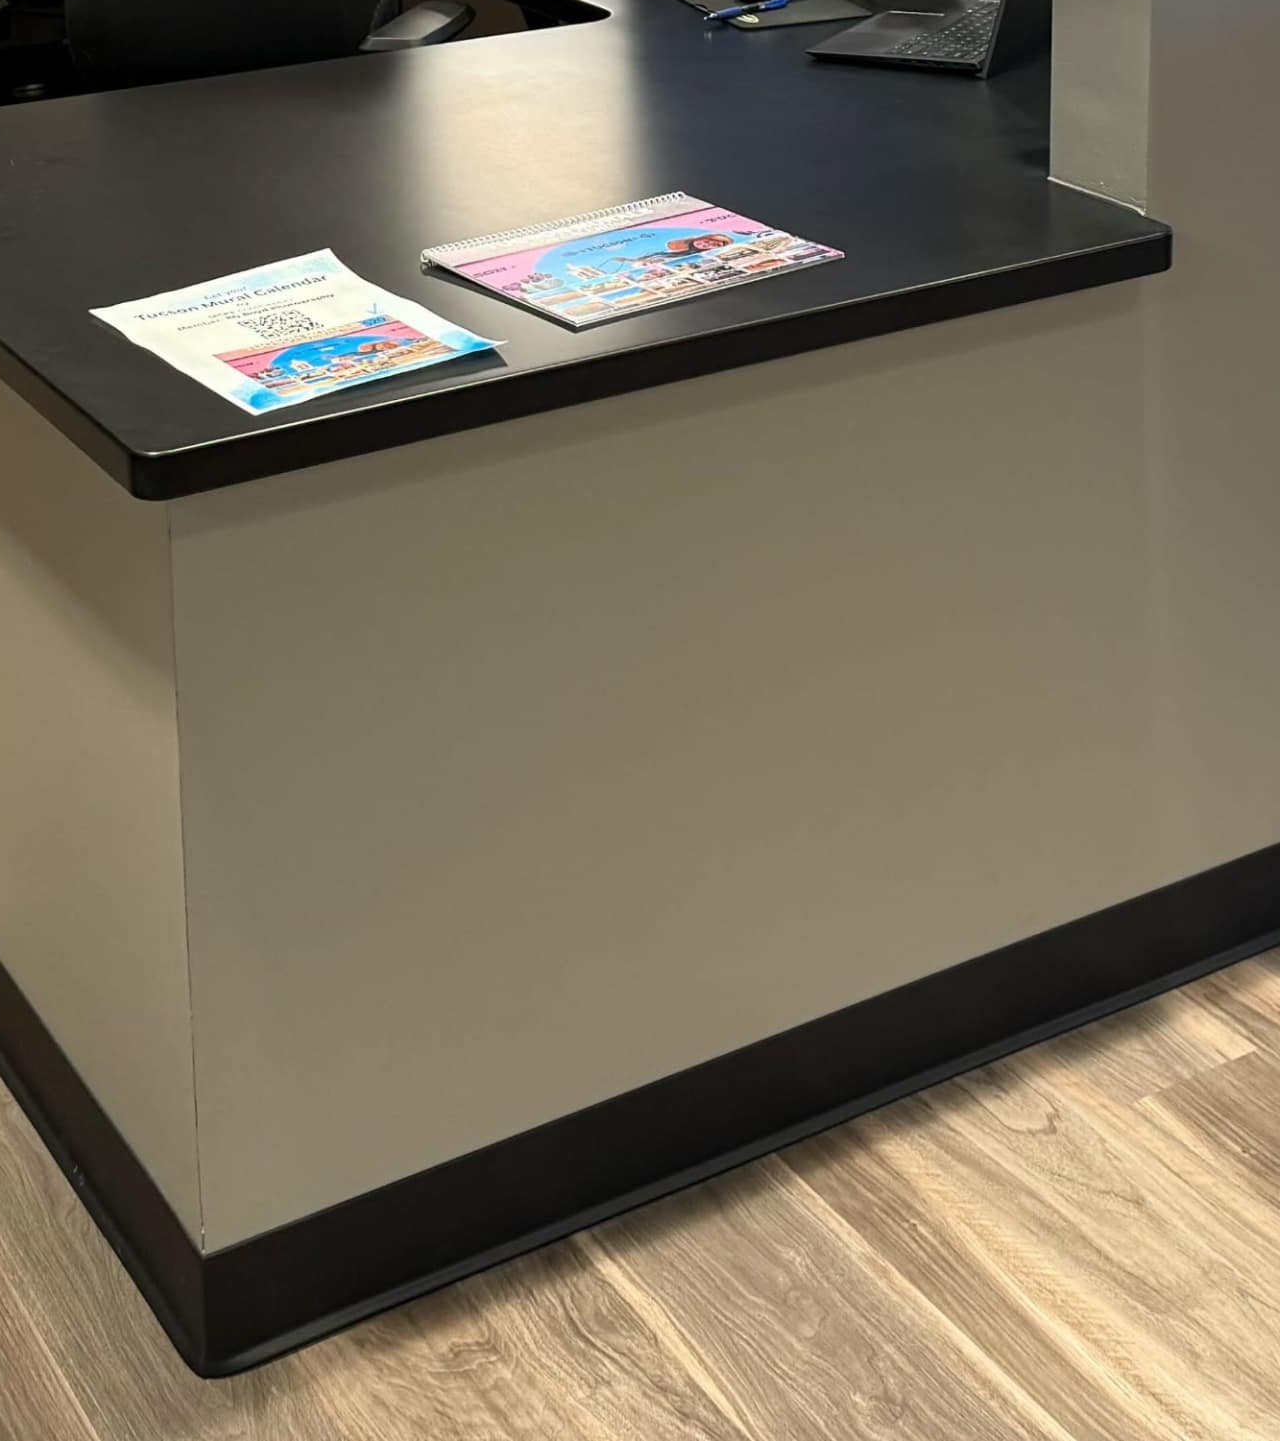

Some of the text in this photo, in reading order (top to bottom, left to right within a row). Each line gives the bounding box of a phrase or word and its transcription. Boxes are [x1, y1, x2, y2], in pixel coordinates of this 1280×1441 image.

[134, 305, 200, 321] Tucson
[200, 292, 252, 309] Mural
[253, 273, 329, 297] Calendar
